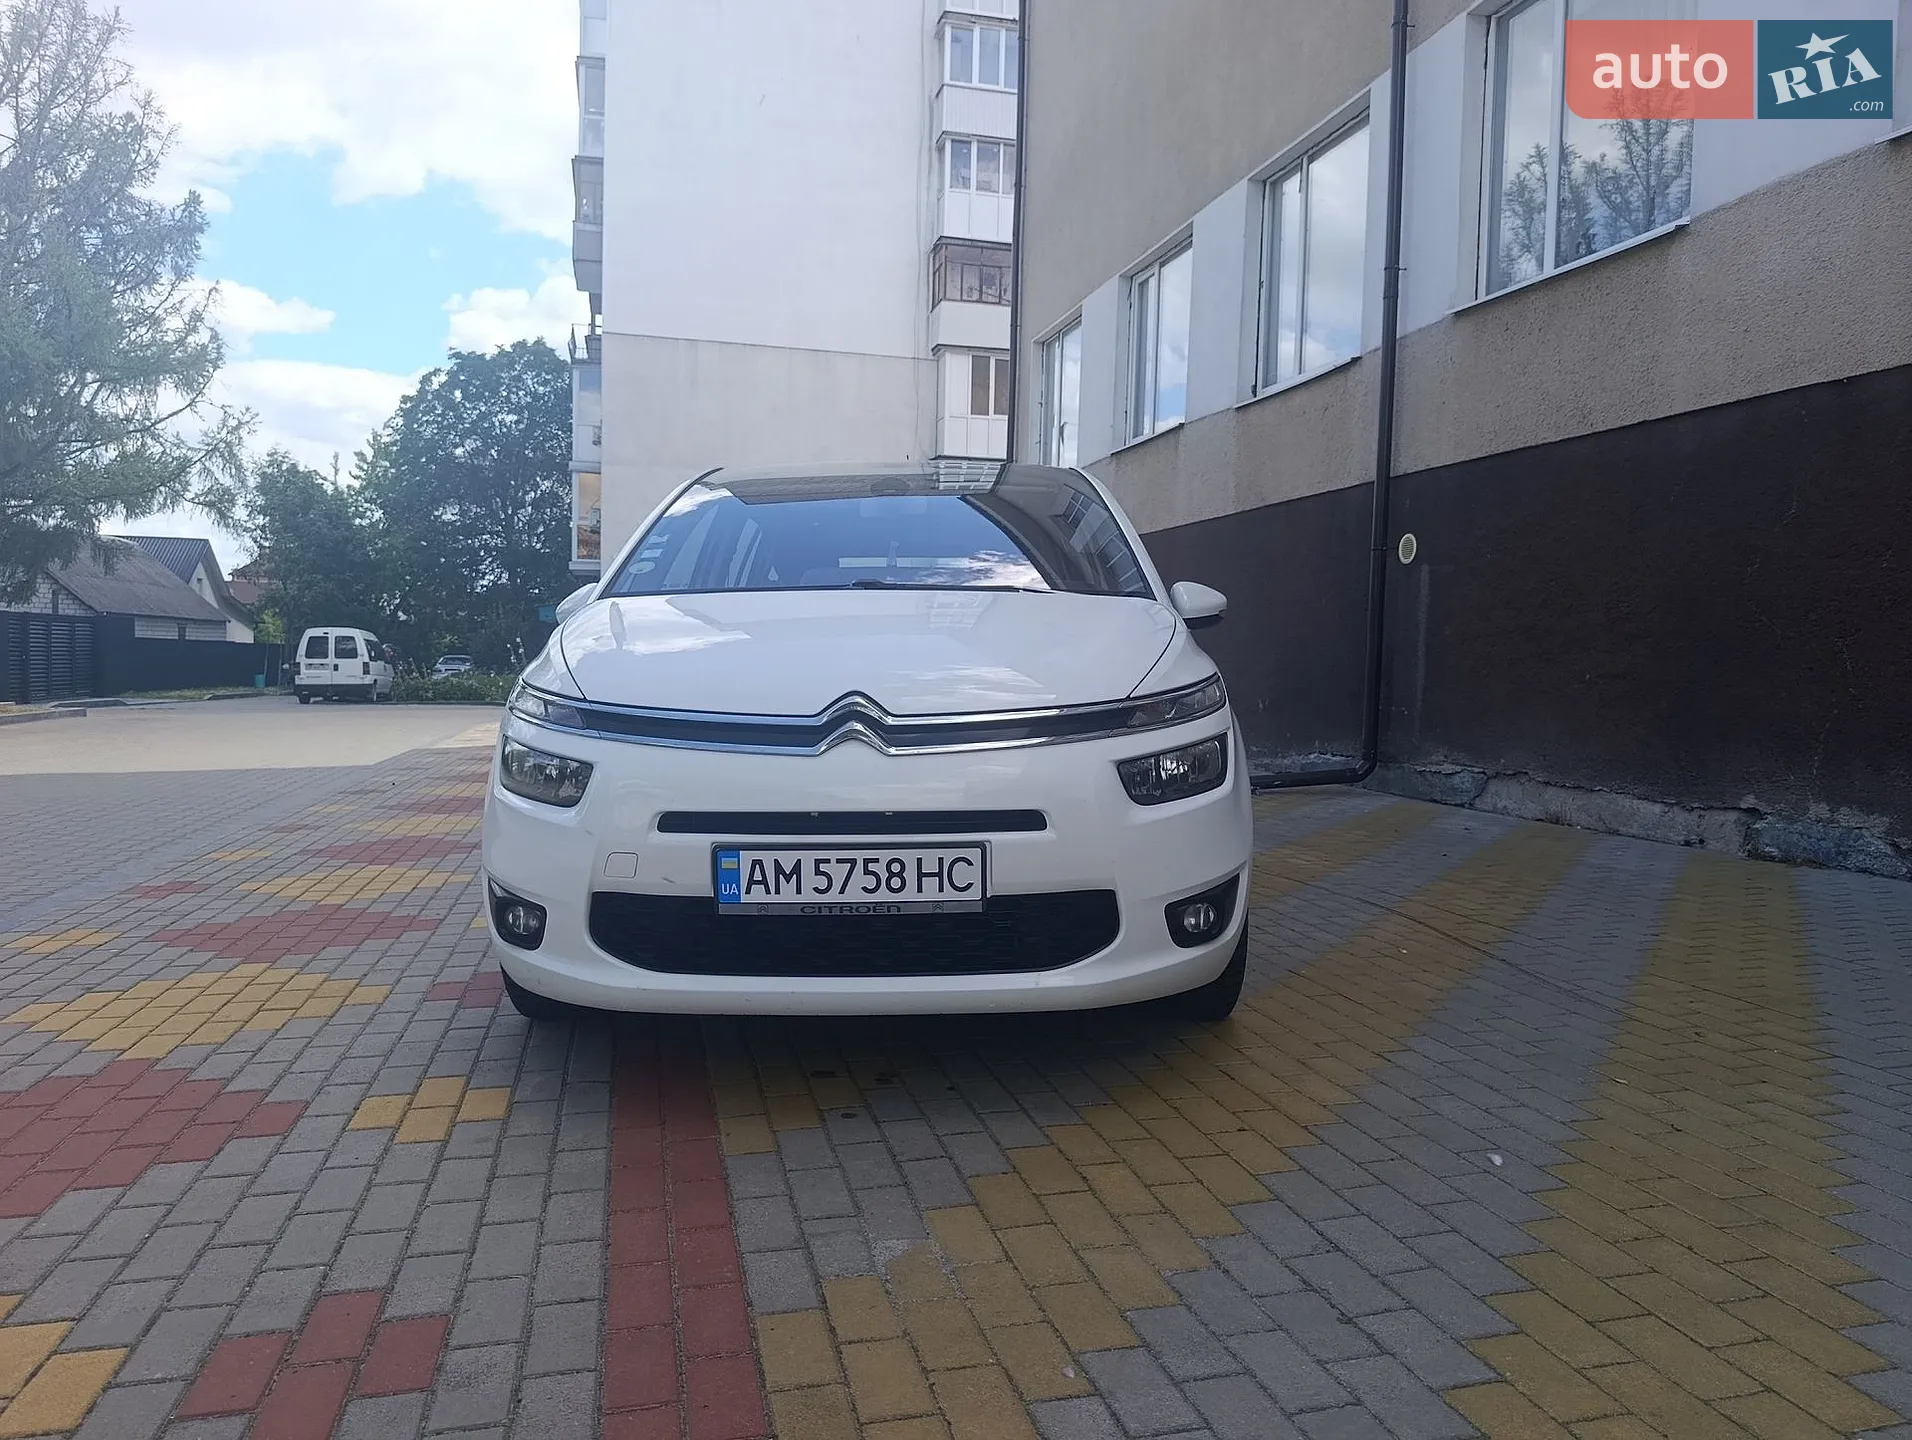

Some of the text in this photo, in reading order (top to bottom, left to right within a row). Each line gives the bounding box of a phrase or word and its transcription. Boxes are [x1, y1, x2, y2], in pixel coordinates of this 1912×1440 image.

[745, 856, 975, 895] AM 5758 HC
[721, 883, 739, 895] UA
